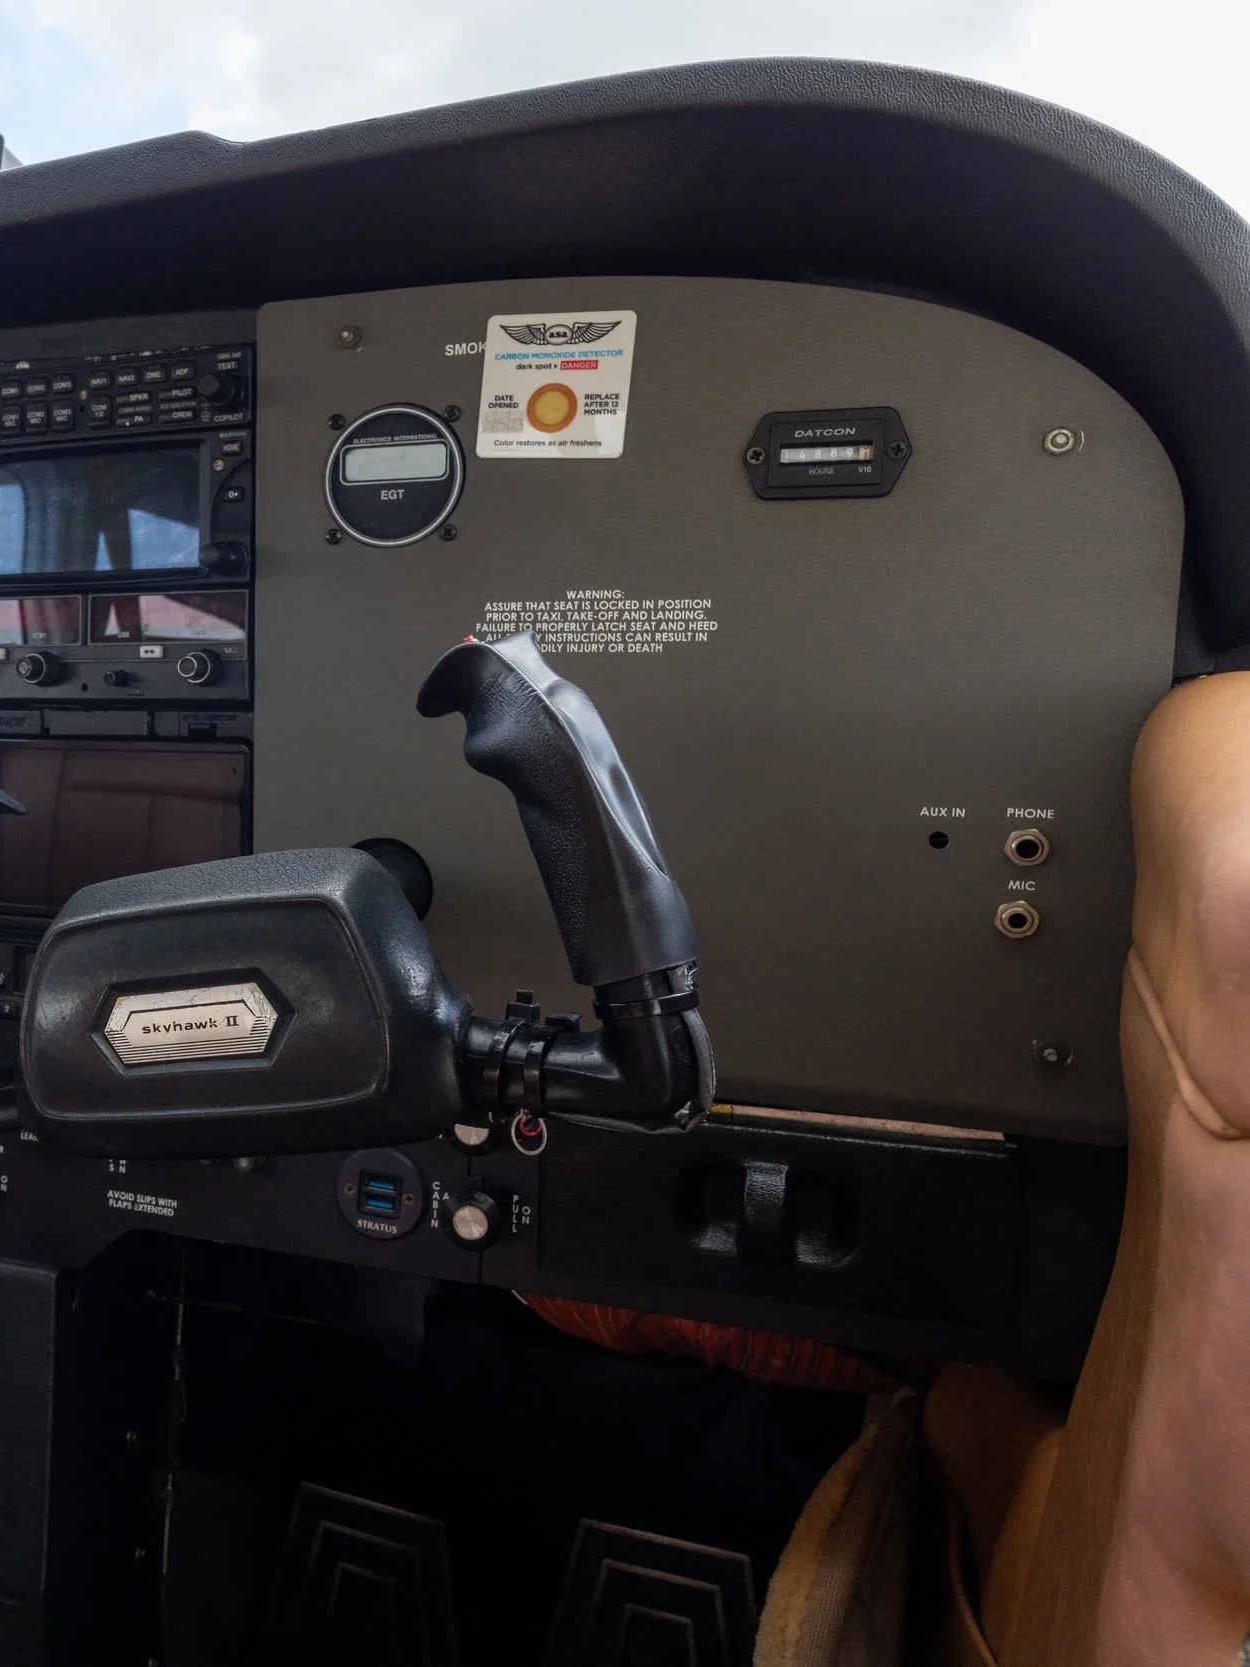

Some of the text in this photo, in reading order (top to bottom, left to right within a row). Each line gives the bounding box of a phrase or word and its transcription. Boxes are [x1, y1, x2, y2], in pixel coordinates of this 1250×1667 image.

[549, 330, 568, 338] asa
[531, 351, 577, 360] MONOXIDE
[578, 350, 624, 358] DETECTOR
[218, 362, 236, 370] TEST
[516, 361, 597, 372] dark spot DANGER
[146, 372, 161, 380] DME
[175, 368, 188, 376] ADF
[92, 378, 107, 386] NAV1
[118, 375, 134, 383] NAV2
[28, 384, 45, 392] COM2
[53, 382, 71, 390] COM3
[2, 388, 19, 396] COM1
[130, 393, 149, 401] SPKR
[172, 388, 192, 397] PILOT
[92, 404, 107, 412] COM
[2, 414, 19, 422] COM1
[214, 414, 244, 422] COPILOT
[794, 428, 856, 438] DATCON
[353, 434, 438, 444] ELECTRONICS INTERNATIONAL
[222, 444, 239, 452] HOME
[380, 489, 405, 500] EGT
[566, 590, 625, 600] WARNING:
[484, 599, 711, 611] ASSURE THAT SEAT IS LOCKED IN POSITION
[486, 610, 707, 622] PRIOR TO TAXI, TAKE-OFF AND LANDING.
[476, 621, 718, 632] FAILURE TO PROPERLY LATCH SEAT AND HEED
[545, 632, 622, 642] INSTRUCTIONS
[626, 632, 652, 642] CAN
[656, 632, 693, 642] RESULT
[696, 632, 708, 641] IN
[566, 643, 605, 652] INJURY
[608, 643, 624, 652] OR
[627, 643, 662, 652] DEATH
[920, 806, 966, 818] AUX IN
[1006, 808, 1054, 819] PHONE
[1008, 880, 1036, 891] MIC
[142, 1017, 218, 1034] skyhawk
[1, 1176, 8, 1192] ON
[107, 1190, 178, 1208] AVOID SLIPS WITH
[109, 1199, 174, 1216] FLAPS EXTENDED
[431, 1181, 440, 1228] CABIN
[522, 1206, 531, 1224] ON
[357, 1219, 398, 1234] STRATUS
